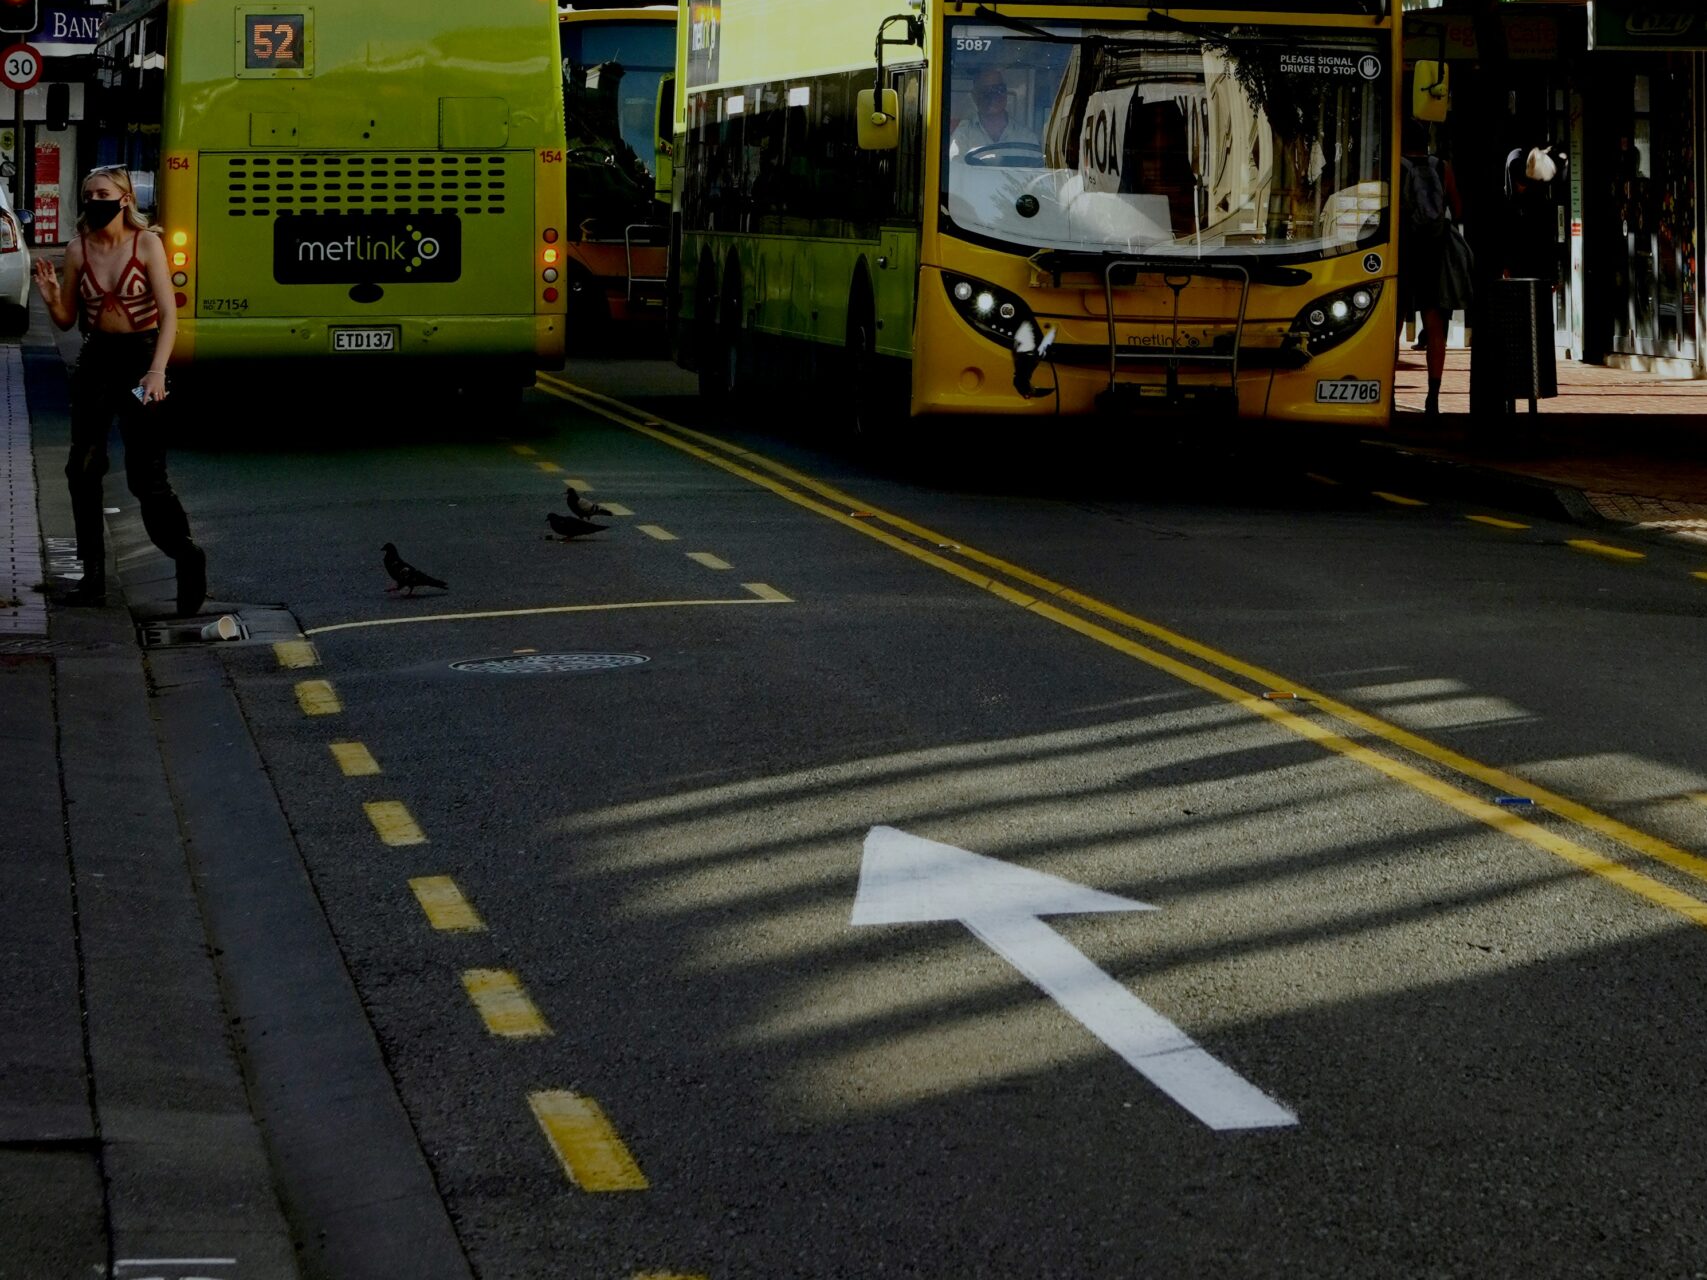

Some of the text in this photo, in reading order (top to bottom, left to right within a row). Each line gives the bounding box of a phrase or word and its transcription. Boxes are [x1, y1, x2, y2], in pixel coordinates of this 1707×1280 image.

[253, 24, 294, 58] 52
[956, 39, 992, 51] 5087
[1280, 55, 1353, 66] PLEASE SIGNAL
[8, 59, 33, 76] 30
[1280, 64, 1357, 76] DRIVER TO STOP
[540, 150, 562, 163] 154
[166, 157, 190, 170] 154
[298, 235, 406, 261] metlink
[216, 298, 249, 311] 7154
[336, 333, 392, 348] ETD137
[1127, 333, 1182, 347] metlink
[1318, 383, 1378, 400] LZZ706
